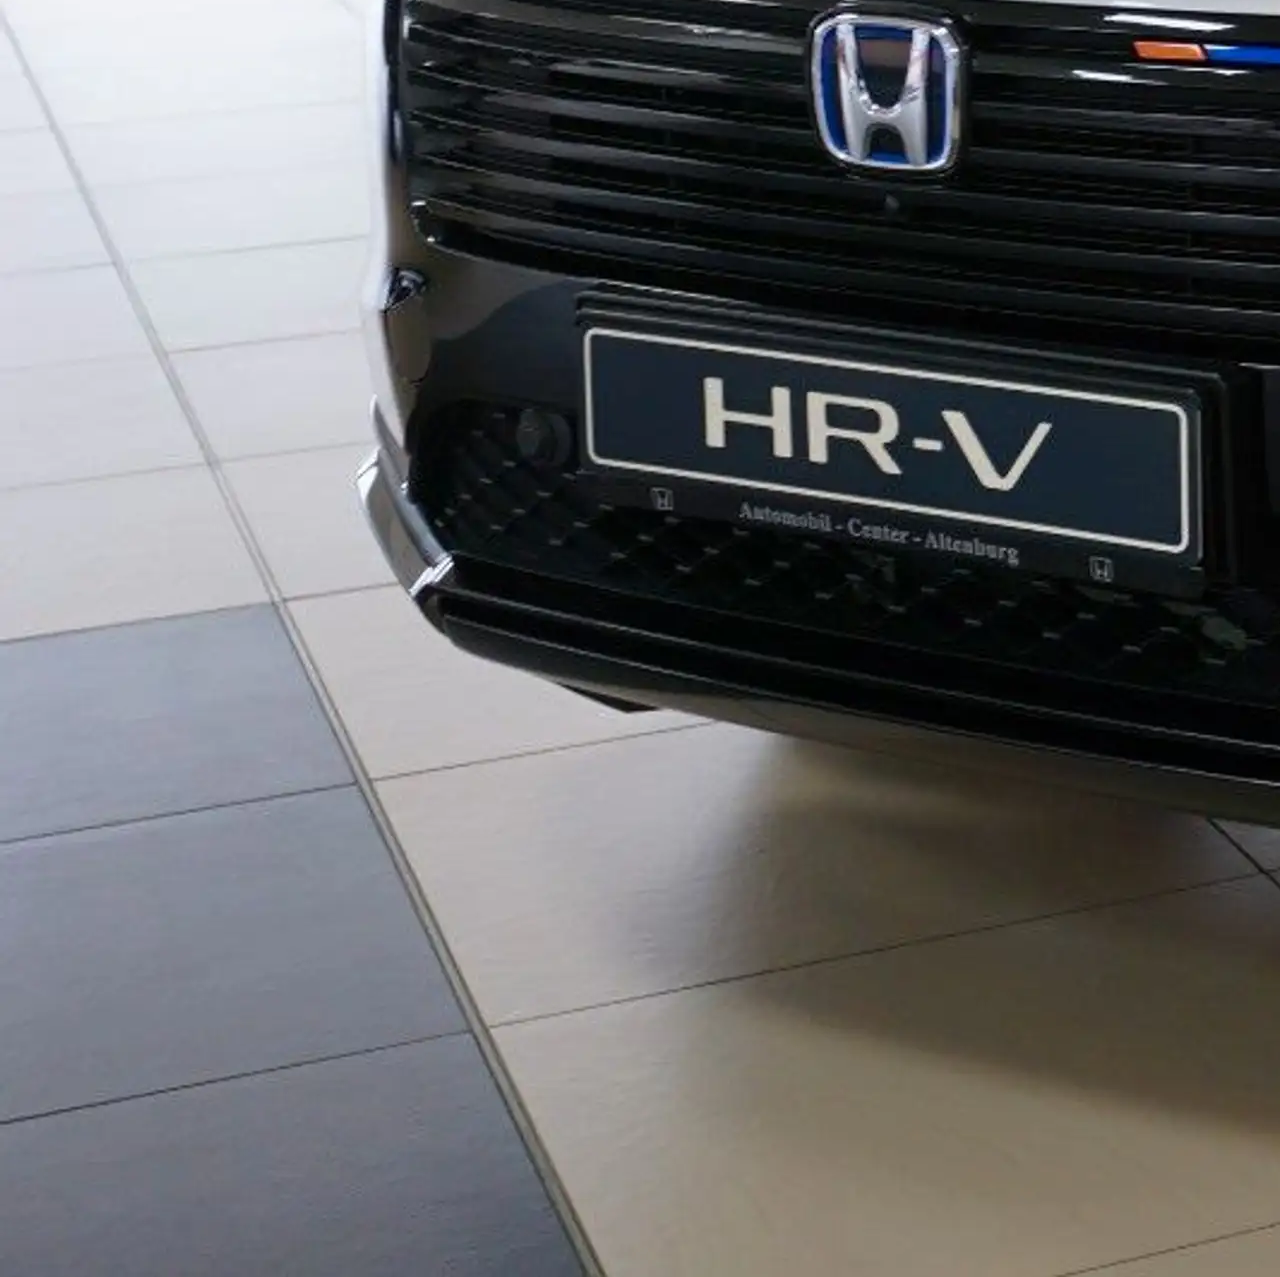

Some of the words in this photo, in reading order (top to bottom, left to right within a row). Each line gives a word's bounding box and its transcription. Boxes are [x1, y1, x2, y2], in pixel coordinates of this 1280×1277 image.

[703, 376, 1053, 491] HR-V
[739, 502, 832, 533] Automobil
[848, 517, 907, 544] Center
[925, 529, 1019, 566] Altenburg
